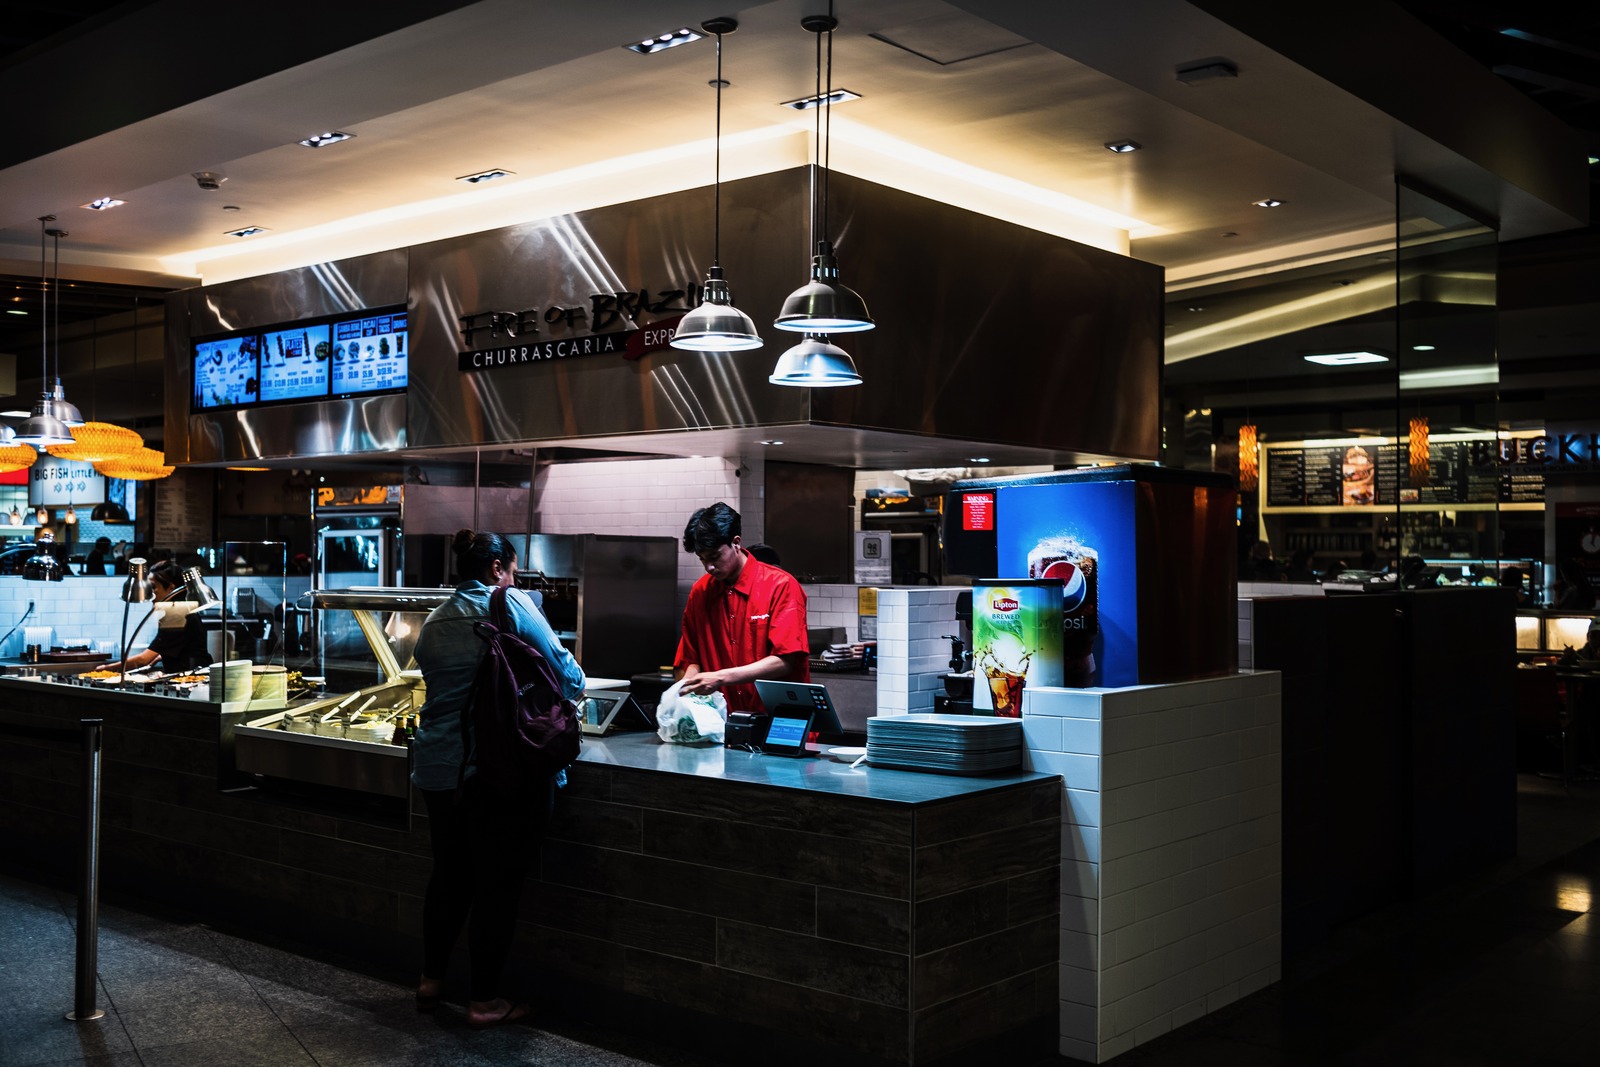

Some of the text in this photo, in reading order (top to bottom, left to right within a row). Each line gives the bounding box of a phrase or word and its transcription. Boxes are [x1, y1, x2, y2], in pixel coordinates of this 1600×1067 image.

[459, 282, 704, 346] FIRE OF BRAZI
[472, 327, 675, 367] CHURRASCARIA EXPR
[35, 468, 48, 481] BIG
[51, 467, 69, 480] FISH
[71, 468, 92, 479] LITTLE
[994, 601, 1018, 610] Lipton
[1063, 615, 1084, 633] psi
